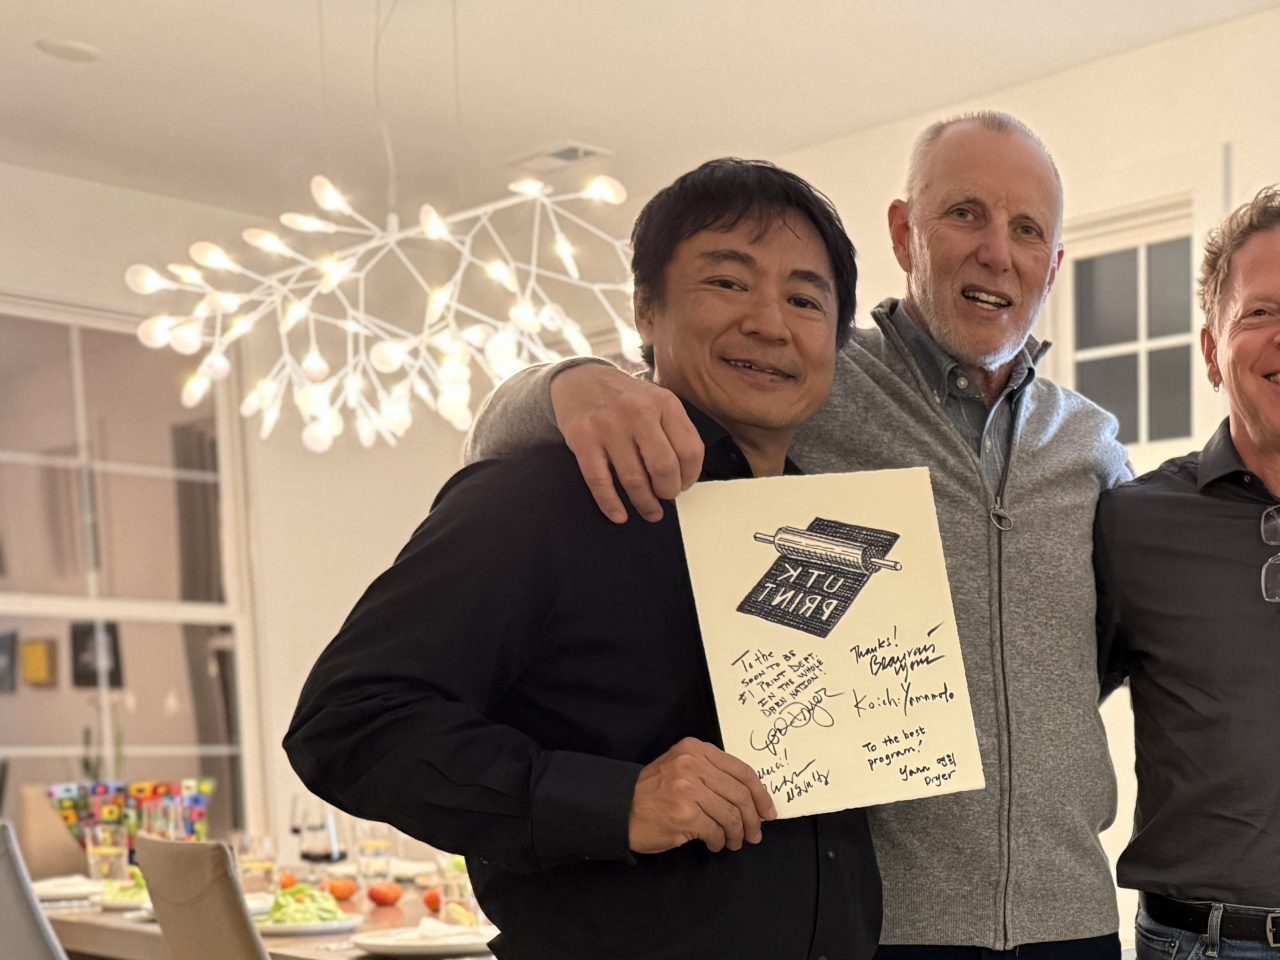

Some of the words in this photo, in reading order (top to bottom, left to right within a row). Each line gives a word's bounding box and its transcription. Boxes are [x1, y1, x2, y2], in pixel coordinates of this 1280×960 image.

[782, 649, 797, 662] BE
[850, 625, 898, 664] Thanks!
[754, 649, 774, 665] the
[756, 670, 787, 692] PRINT
[758, 692, 776, 707] IN
[777, 678, 795, 691] THE
[797, 658, 824, 678] WHOLE
[862, 742, 877, 752] To
[882, 735, 900, 746] the
[902, 725, 926, 740] best
[924, 770, 956, 787] Dryer
